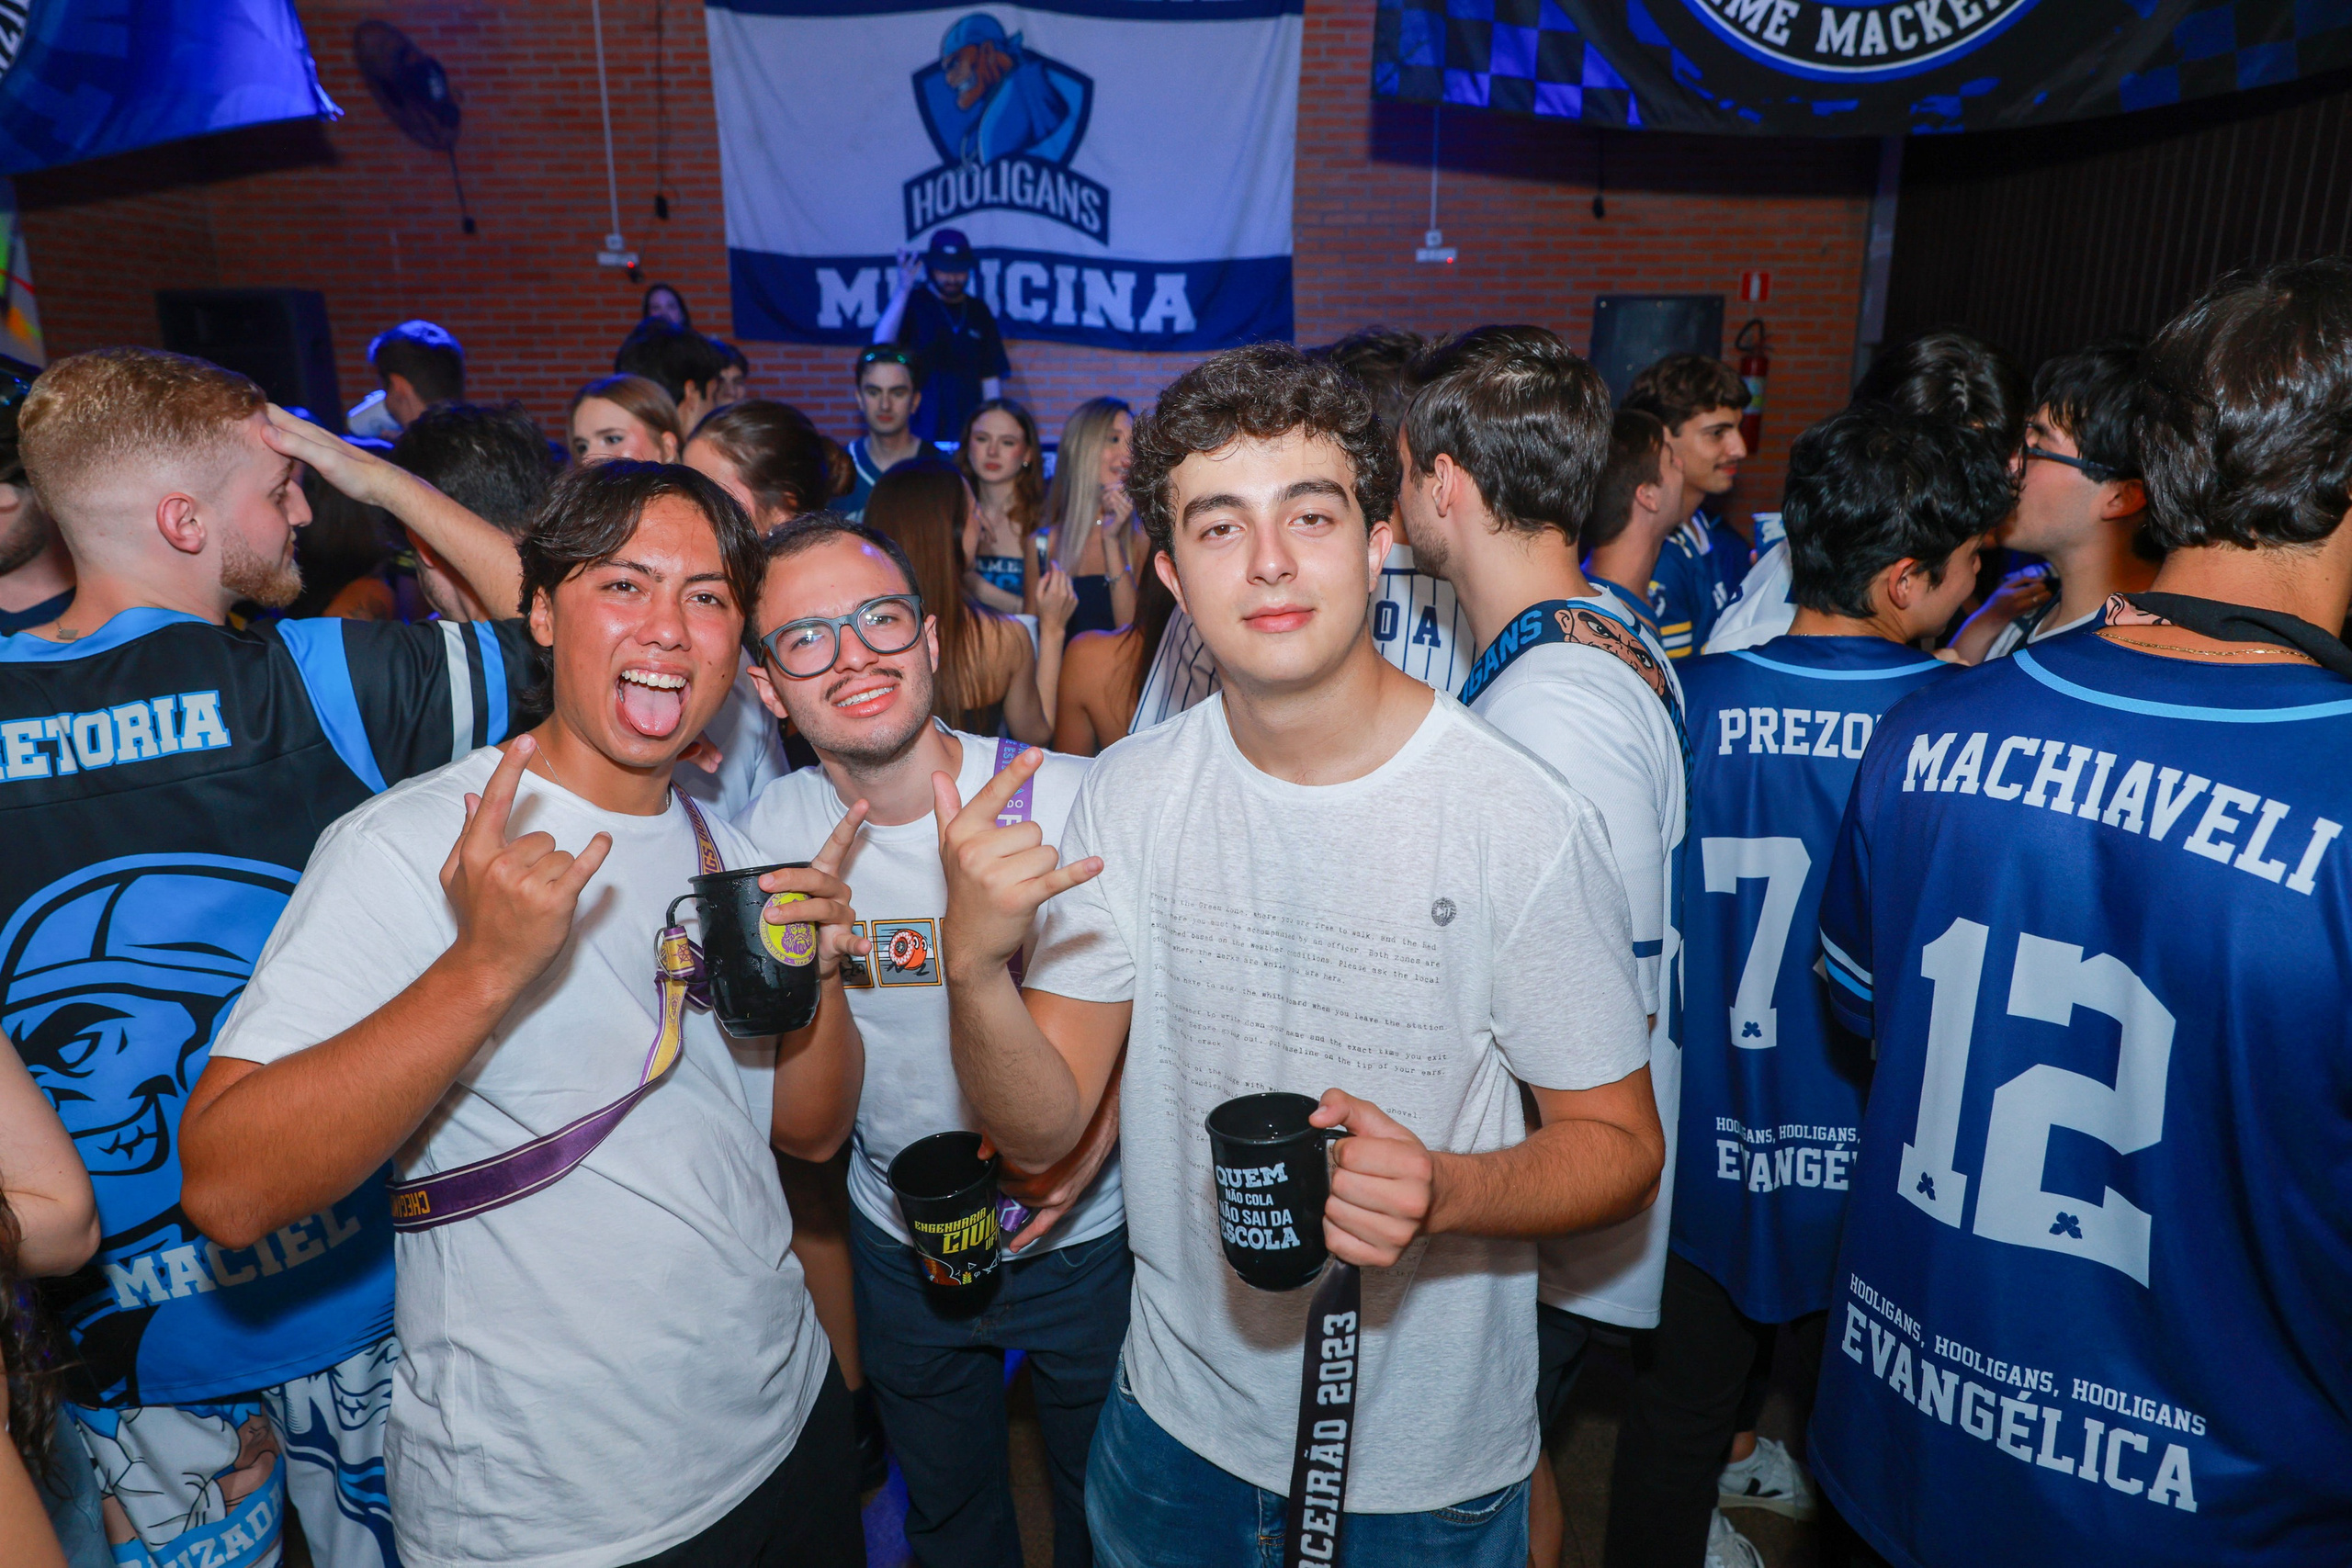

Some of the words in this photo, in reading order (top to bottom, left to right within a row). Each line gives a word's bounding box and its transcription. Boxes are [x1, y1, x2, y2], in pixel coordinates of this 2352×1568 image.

[1815, 0, 2003, 57] MACKE
[910, 159, 1102, 234] HOOLIGANS
[815, 258, 1198, 334] MICINA
[0, 690, 232, 782] ETORIA
[1718, 707, 1883, 760] PREZO
[1903, 731, 2345, 896] MACHIAVELI
[1170, 913, 1187, 921] here
[1299, 935, 1307, 944] by
[1368, 949, 1389, 959] Both
[1395, 955, 1420, 964] zones
[1199, 902, 1222, 911] Green
[1315, 922, 1333, 931] free
[1381, 935, 1396, 943] and
[1403, 938, 1417, 948] the
[1701, 837, 1812, 1049] 7
[1192, 932, 1214, 942] based
[1232, 939, 1244, 947] the
[1250, 942, 1283, 953] weather
[1339, 960, 1366, 973] Please
[1372, 967, 1387, 976] ask
[1394, 970, 1408, 979] the
[1415, 974, 1440, 983] local
[1245, 1020, 1265, 1029] down
[1310, 1034, 1325, 1043] and
[1330, 1038, 1342, 1047] the
[1347, 1044, 1372, 1054] exact
[1379, 1049, 1399, 1057] time
[1313, 1003, 1330, 1012] when
[1335, 1009, 1350, 1017] you
[1354, 1012, 1379, 1023] leave
[1385, 1019, 1400, 1027] the
[1189, 1021, 1216, 1032] Before
[1338, 1056, 1351, 1066] the
[1357, 1061, 1373, 1070] tip
[1395, 1066, 1416, 1074] your
[1245, 1080, 1265, 1090] with
[1897, 917, 2177, 1289] 12
[1779, 1124, 1860, 1144] HOOLIGANS,
[1215, 1162, 1289, 1188] QUEM
[1225, 1189, 1243, 1204] NÃO
[1245, 1193, 1273, 1206] COLA
[914, 1207, 987, 1234] ENGENHARIA
[1219, 1200, 1239, 1223] NÃO
[1242, 1209, 1267, 1226] SAI
[1271, 1209, 1293, 1227] DA
[1219, 1215, 1300, 1250] ESCOLA
[1317, 1310, 1357, 1405] 2023
[1849, 1273, 1925, 1348] HOOLIGANS,
[1934, 1334, 2059, 1398] HOOLIGANS,
[2072, 1378, 2206, 1436] HOOLIGANS
[1841, 1301, 2198, 1513] EVANGÉLICA
